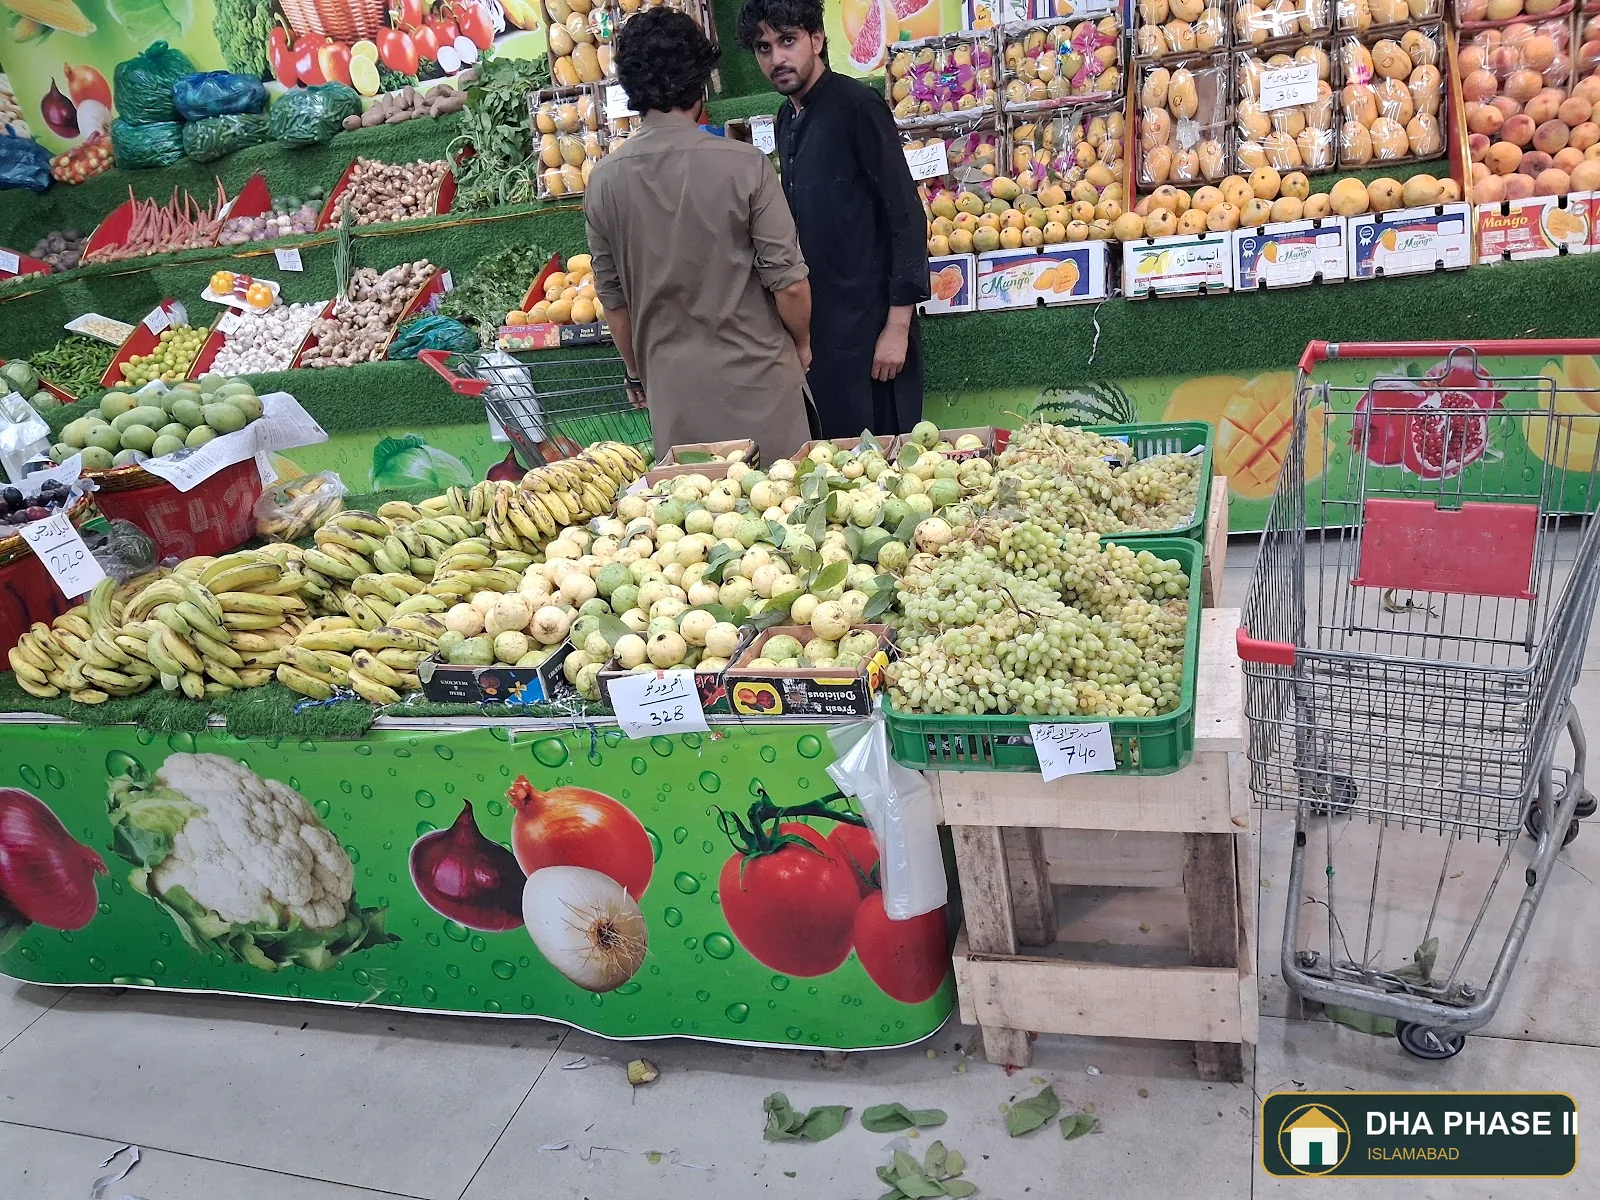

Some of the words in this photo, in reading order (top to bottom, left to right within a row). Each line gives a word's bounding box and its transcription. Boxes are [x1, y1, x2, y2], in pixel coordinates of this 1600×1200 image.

[1276, 88, 1298, 101] 366
[919, 164, 937, 177] 488
[1482, 216, 1528, 229] Mango
[1397, 236, 1433, 251] Mango
[1278, 249, 1312, 262] Mango
[981, 275, 1030, 294] Mango
[50, 550, 84, 574] 220
[807, 690, 857, 701] Delicious
[650, 705, 684, 727] 328
[825, 705, 857, 715] Fresh
[1059, 743, 1097, 765] 740
